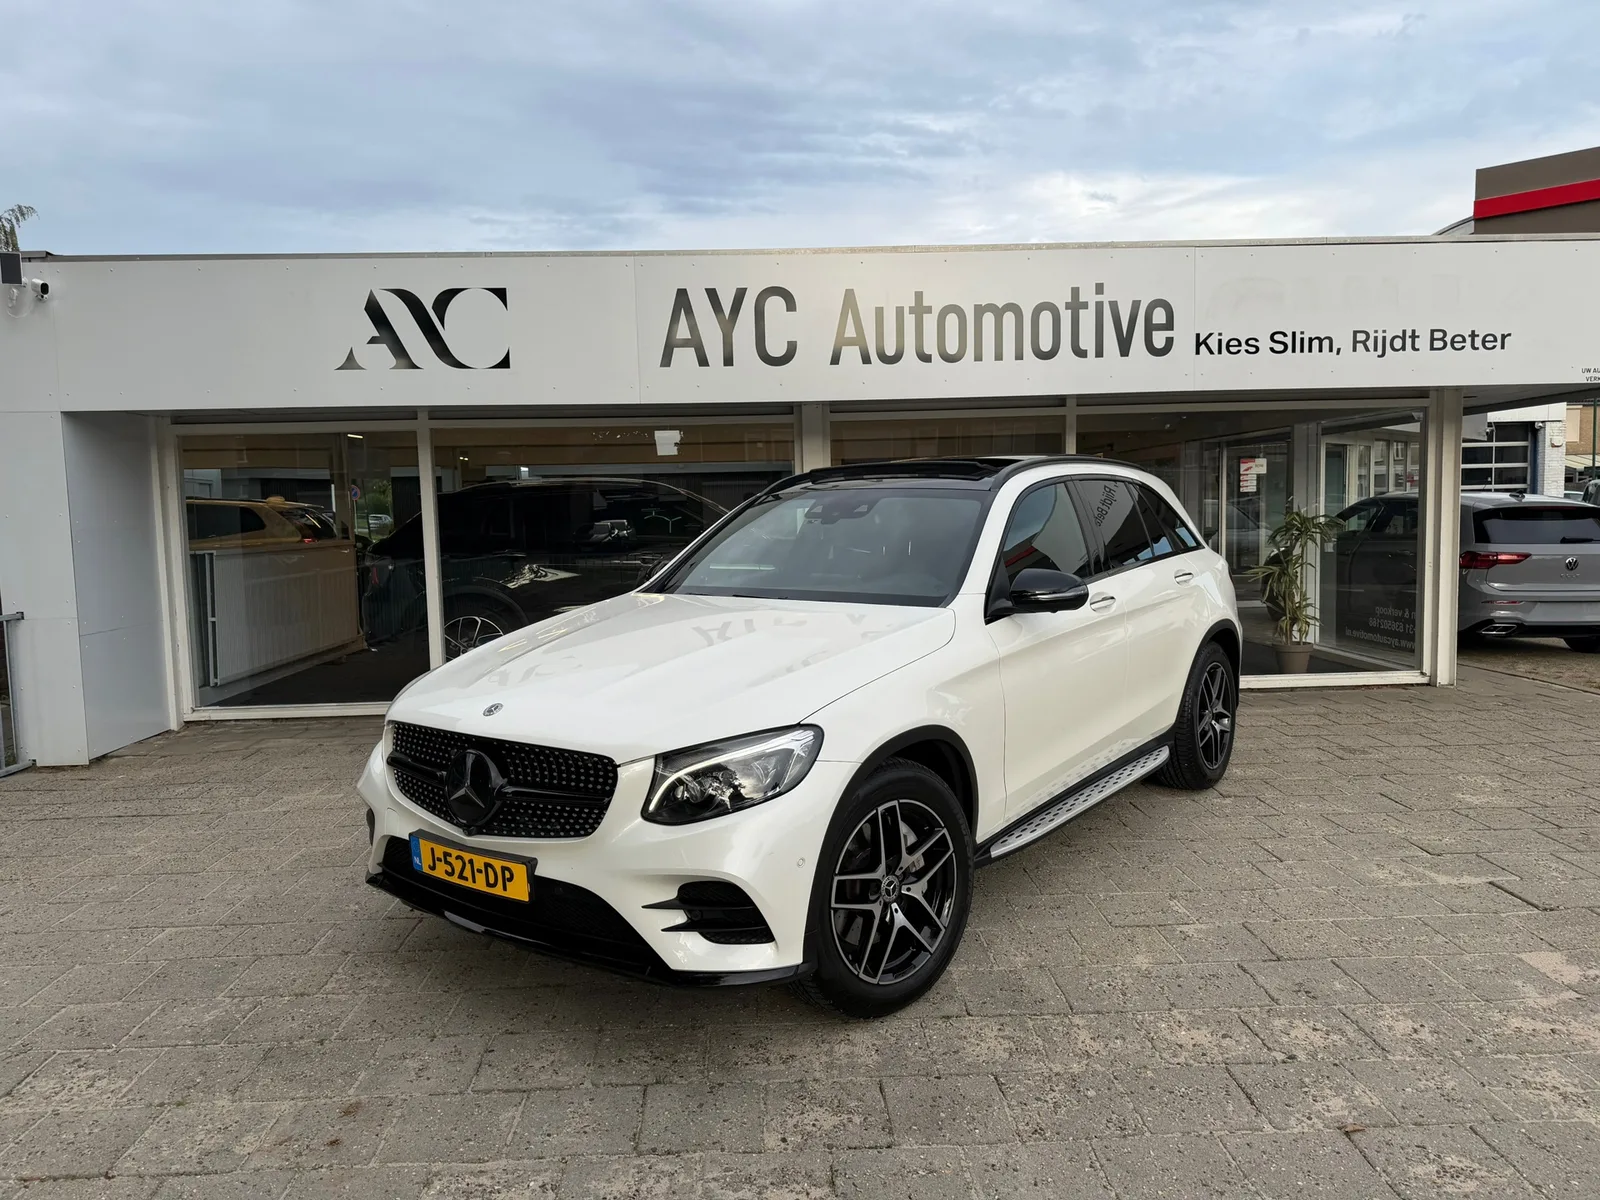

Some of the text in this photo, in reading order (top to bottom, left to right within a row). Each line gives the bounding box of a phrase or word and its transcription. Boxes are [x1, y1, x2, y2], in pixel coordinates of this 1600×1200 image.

[660, 285, 797, 368] AYC
[829, 282, 1176, 366] Automotive
[1195, 328, 1512, 359] Kies Slim, Rijdt Beter
[414, 847, 515, 892] NL J-521-DP
